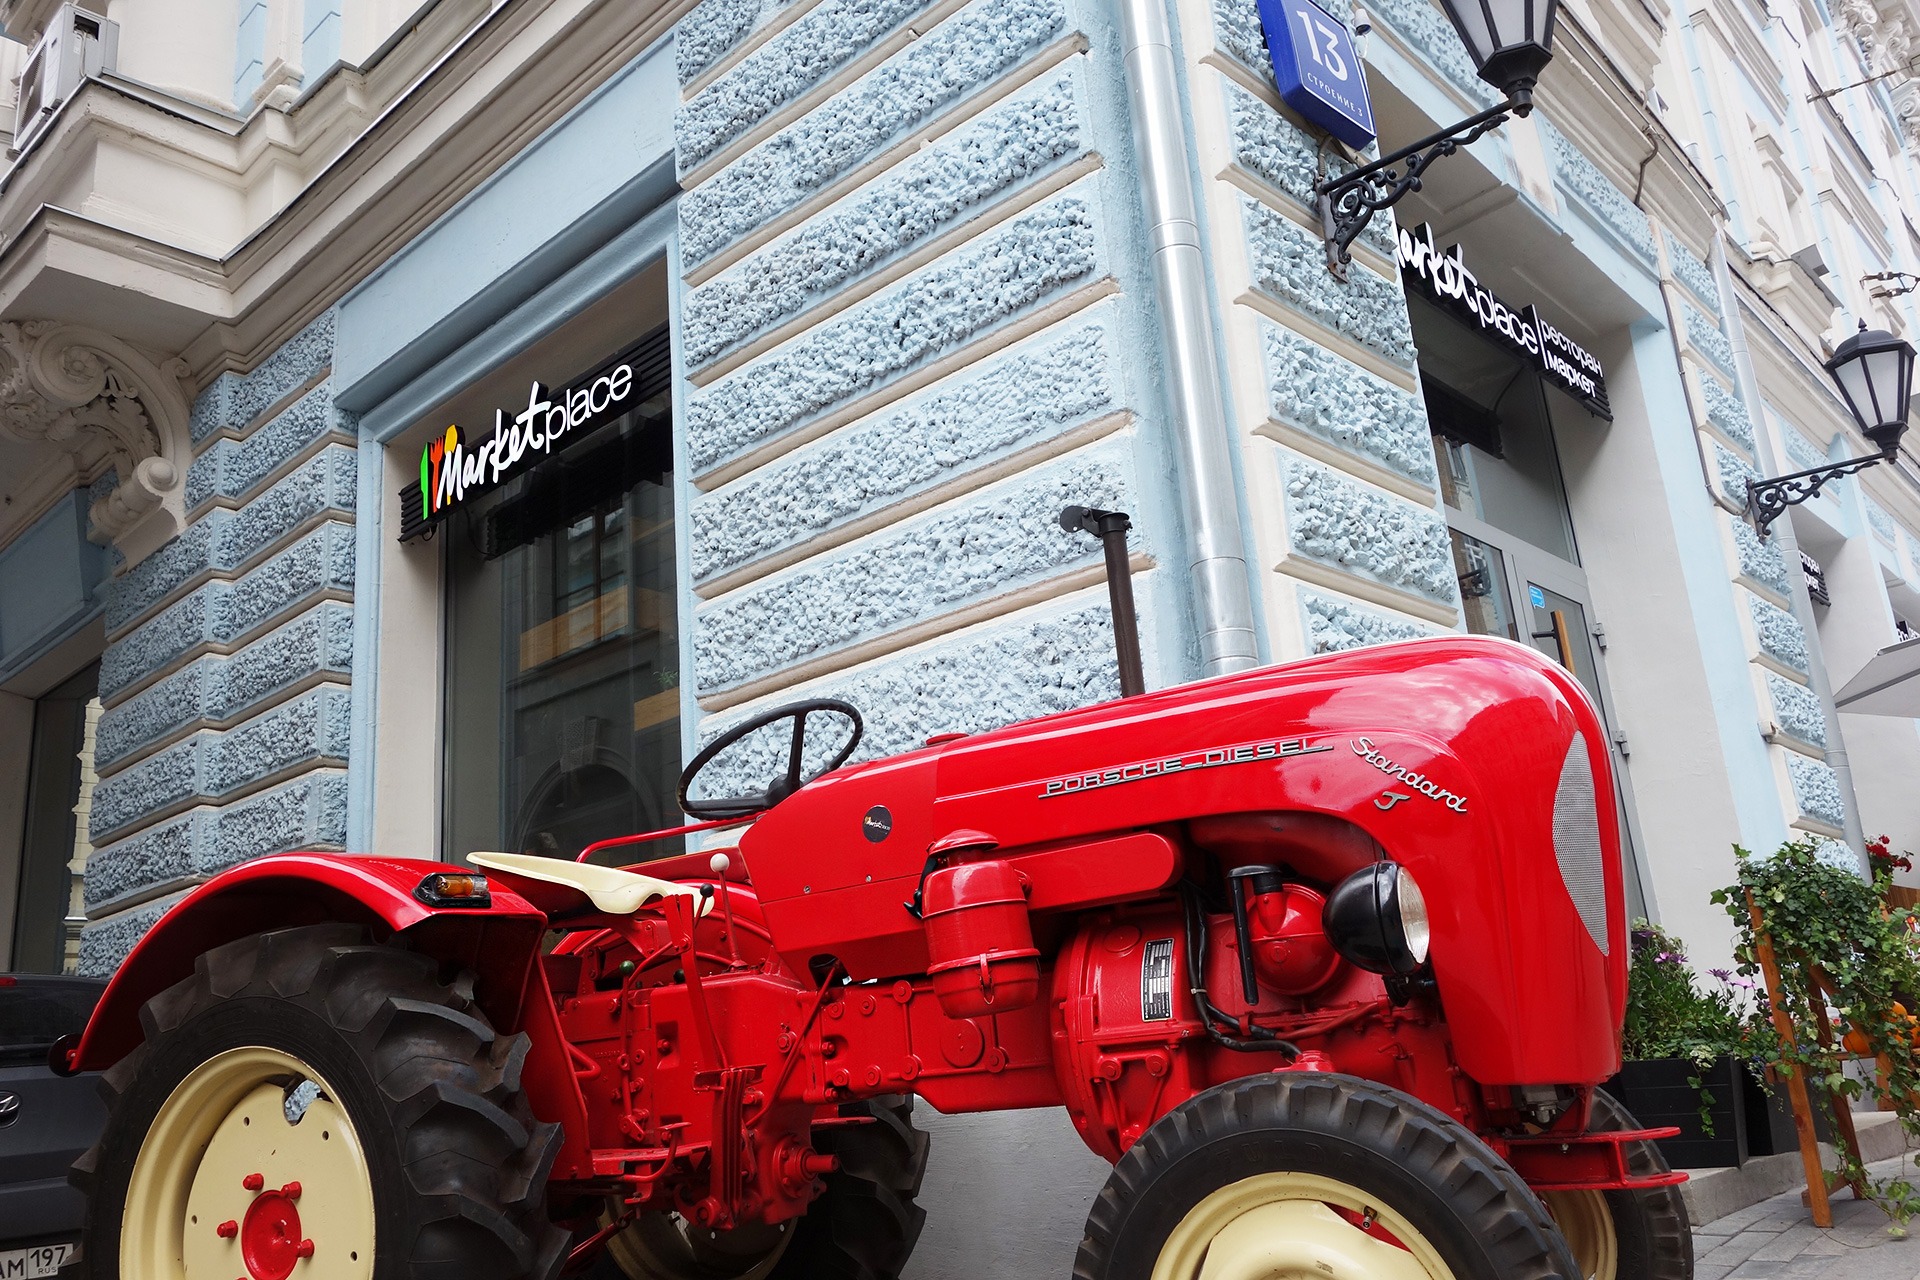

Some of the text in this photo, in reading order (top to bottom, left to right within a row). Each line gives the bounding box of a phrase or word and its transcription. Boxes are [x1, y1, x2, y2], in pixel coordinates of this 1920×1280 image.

[1296, 10, 1348, 82] 13
[1307, 72, 1363, 117] СТРОЕНИЕ 3
[1398, 221, 1538, 355] arketplace
[1540, 318, 1603, 377] ресторан
[1546, 349, 1596, 398] маркет
[1046, 738, 1323, 795] PORSCHE DIESEL
[1349, 736, 1468, 813] Standard
[30, 1246, 66, 1267] 197
